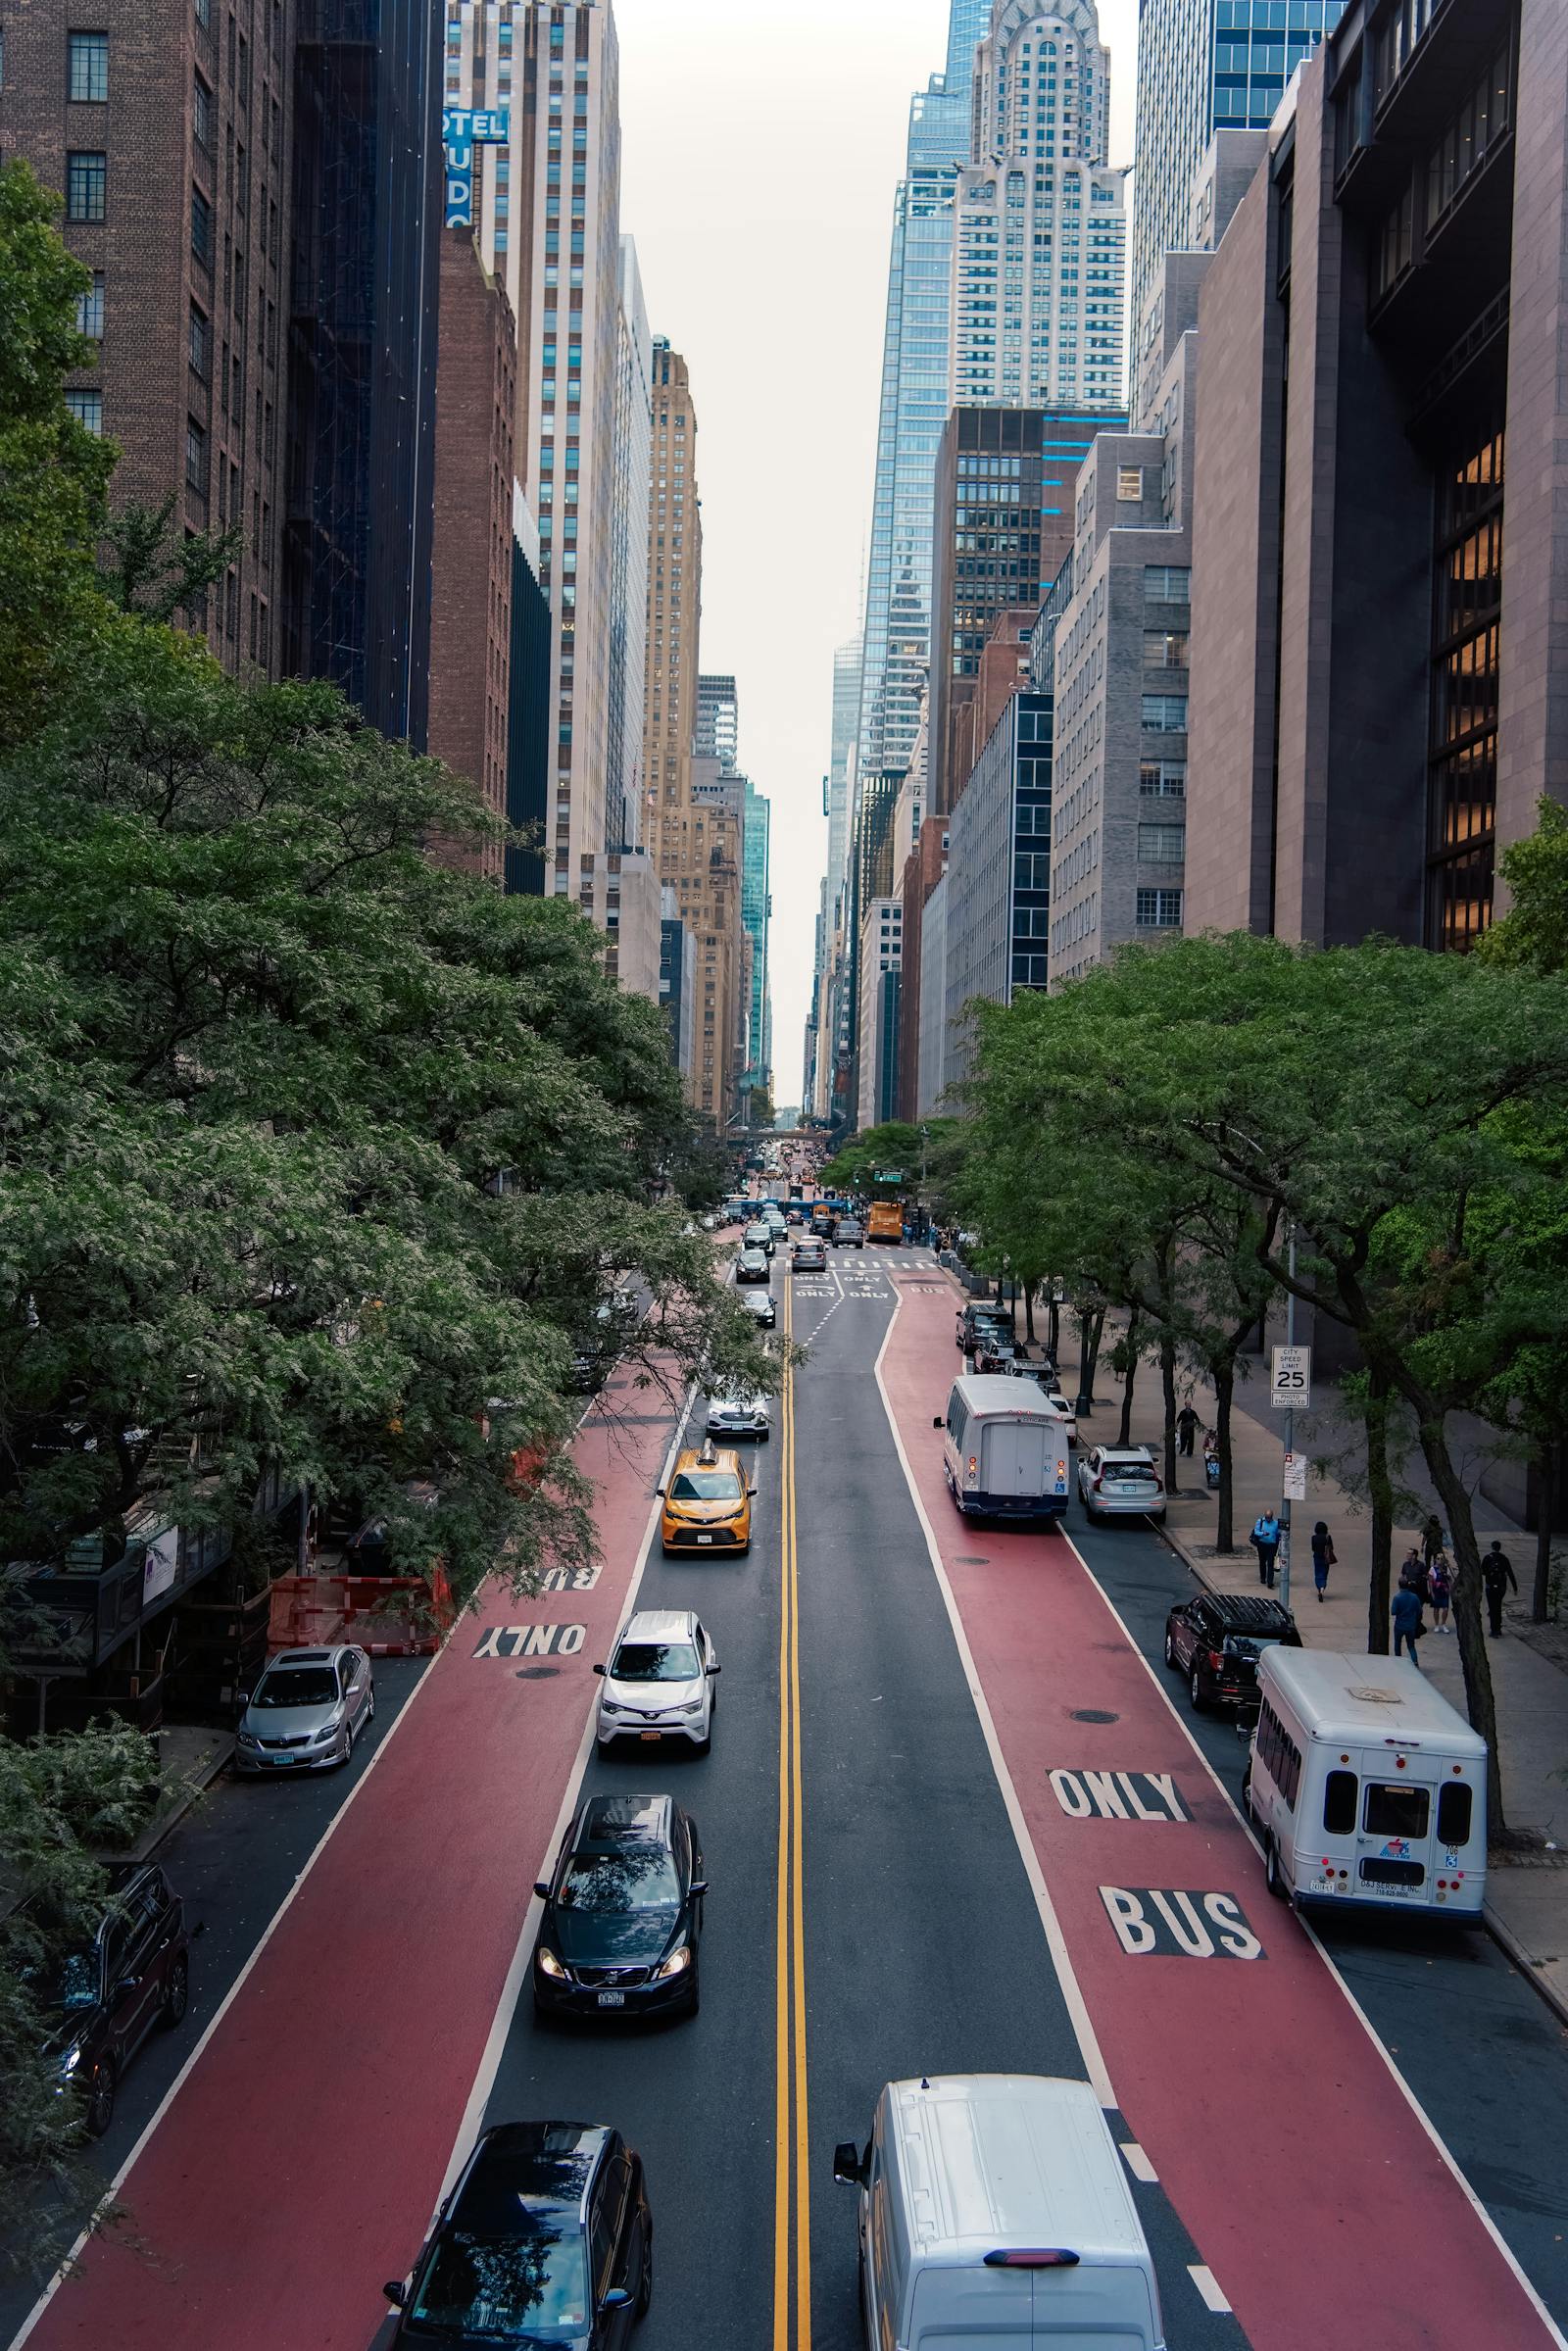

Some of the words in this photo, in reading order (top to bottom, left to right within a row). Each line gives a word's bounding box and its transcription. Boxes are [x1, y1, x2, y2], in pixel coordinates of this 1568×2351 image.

[1277, 1371, 1304, 1388] 25
[471, 1624, 587, 1657] ONLY
[1049, 1769, 1189, 1822] ONLY
[1099, 1886, 1262, 1960] BUS
